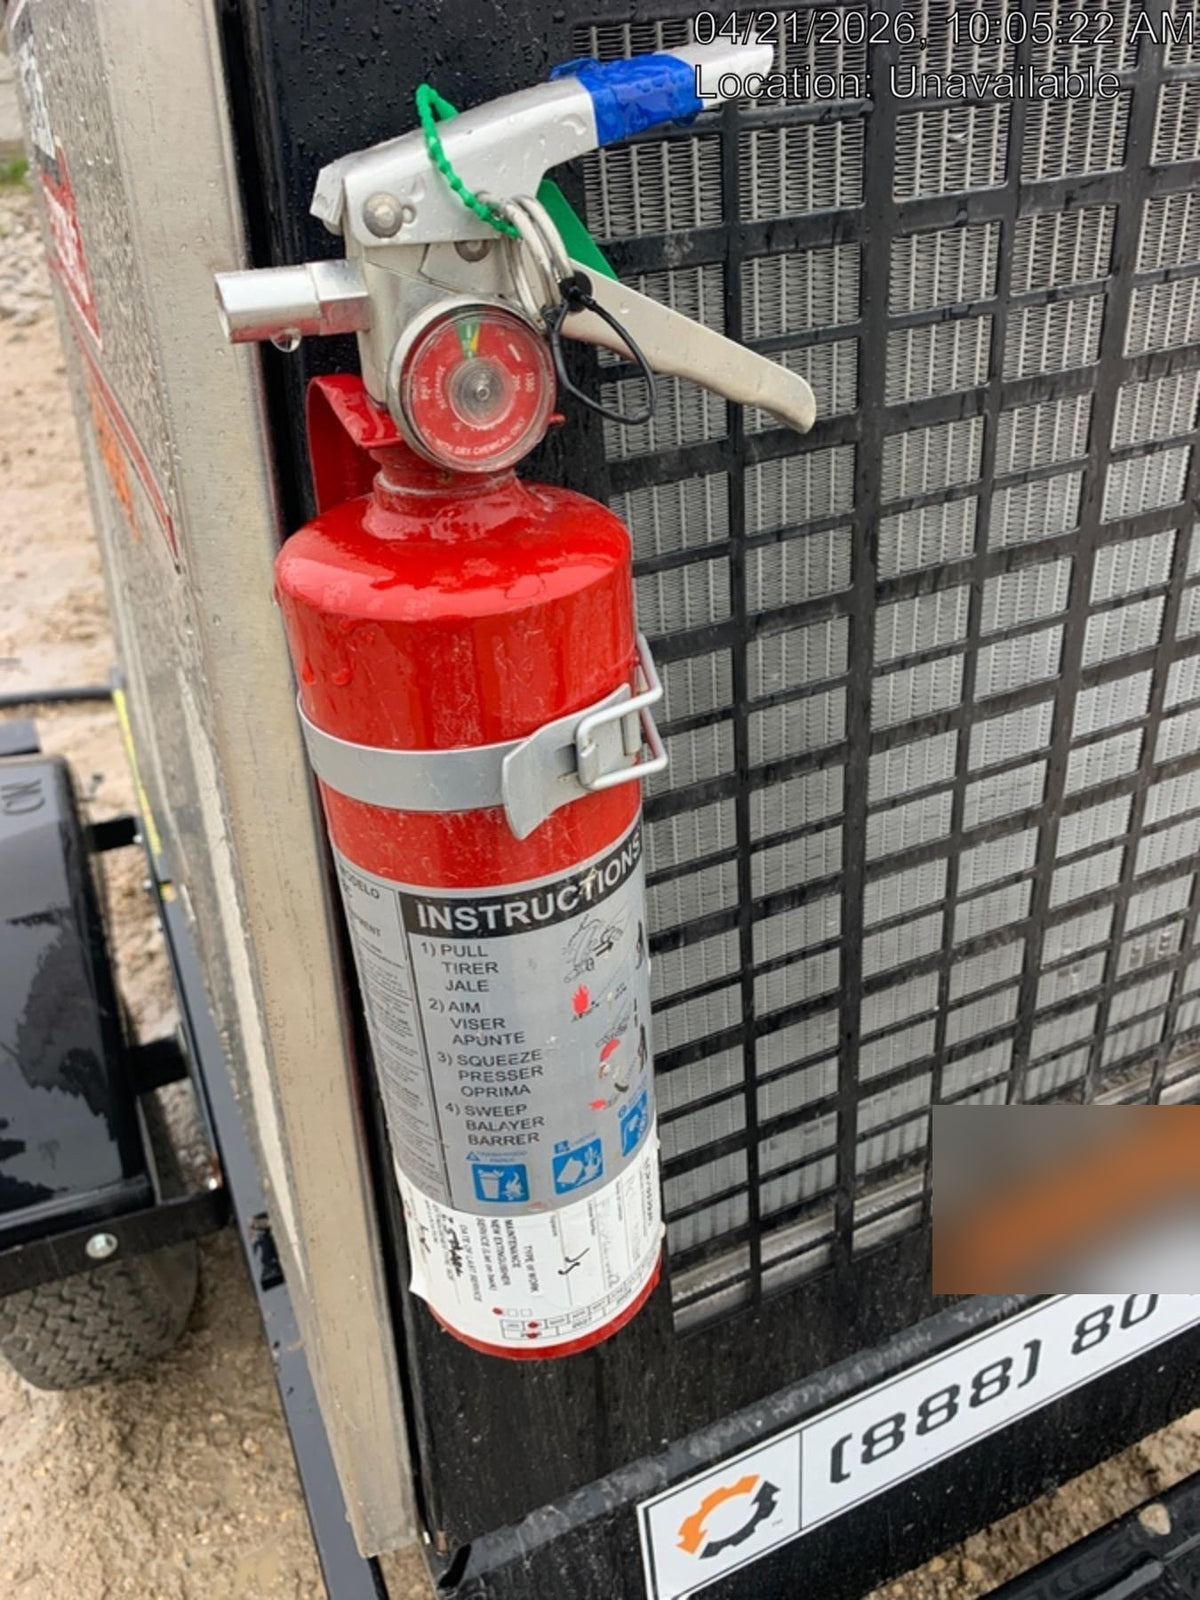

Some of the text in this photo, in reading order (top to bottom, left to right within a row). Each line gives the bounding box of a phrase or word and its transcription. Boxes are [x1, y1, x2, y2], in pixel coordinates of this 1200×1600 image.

[417, 837, 641, 931] INSTRUCTIONS
[421, 942, 489, 958] 1) PULL
[441, 961, 499, 975] TIRER
[445, 979, 490, 993] JALE
[428, 998, 481, 1014] 2) AIM
[450, 1018, 506, 1031] VISER
[452, 1031, 526, 1046] APUNTE
[437, 1049, 544, 1067] 3) SQUEEZE
[458, 1065, 544, 1083] PRESSER
[460, 1085, 531, 1099] OPRIMA
[445, 1103, 527, 1117] 4) SWEEP
[466, 1115, 545, 1132] BALAYER
[468, 1132, 541, 1147] BARRER
[829, 1338, 1042, 1484] (888)
